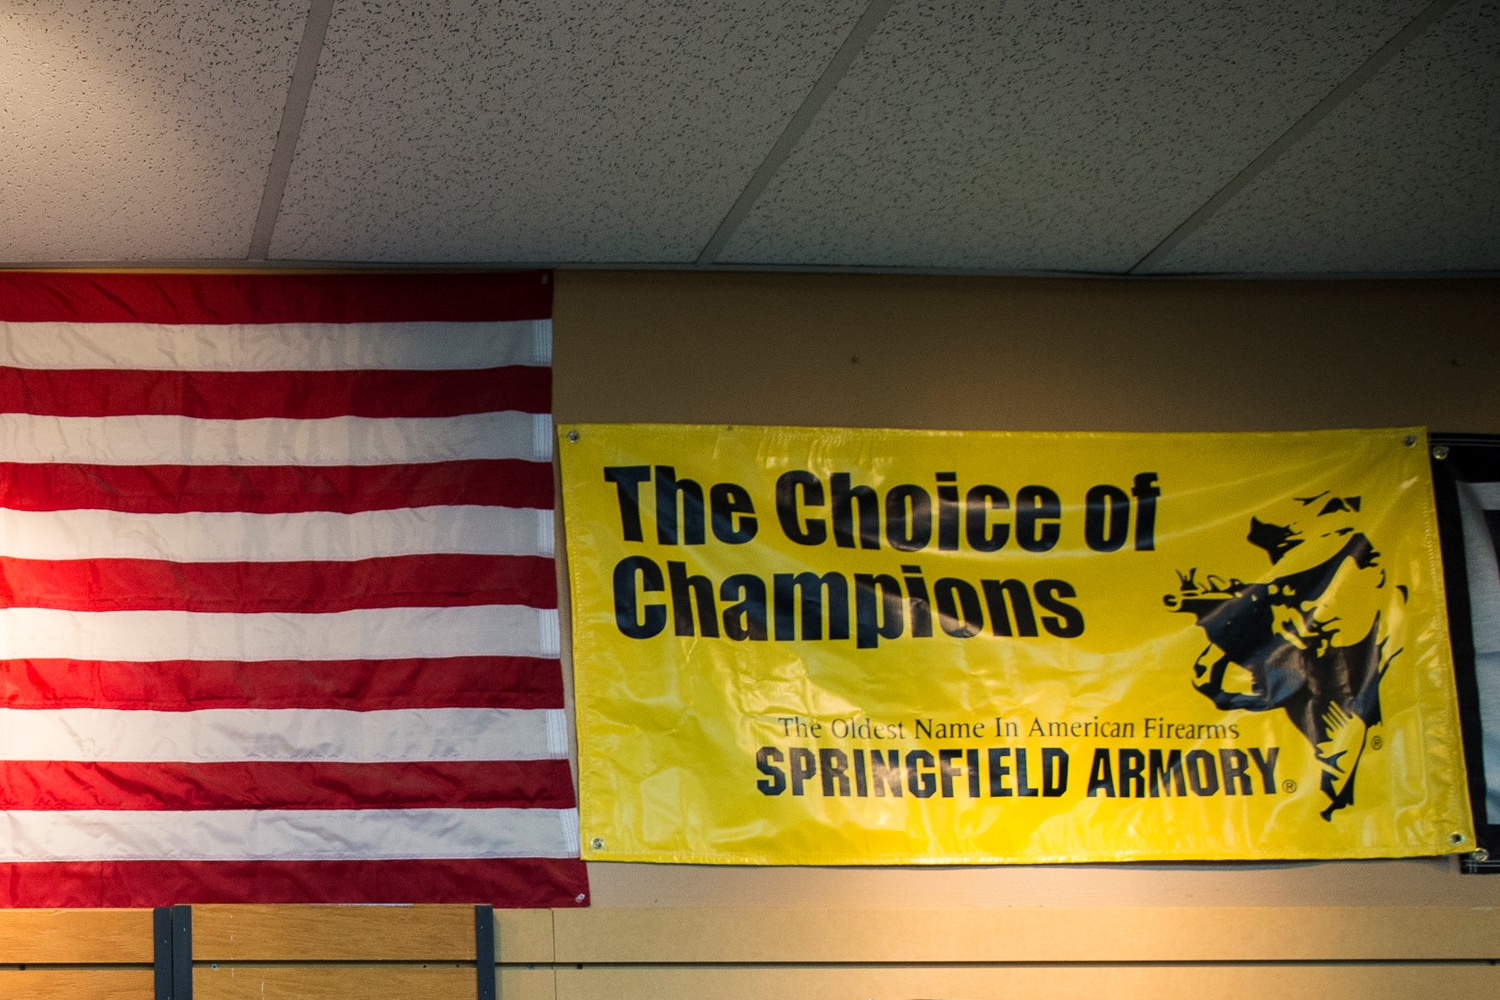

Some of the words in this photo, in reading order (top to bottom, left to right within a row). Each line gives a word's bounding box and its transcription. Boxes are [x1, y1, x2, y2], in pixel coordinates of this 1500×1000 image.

[605, 465, 758, 546] The
[776, 470, 1061, 555] Choice
[1084, 471, 1162, 552] of
[612, 554, 1085, 649] Champions
[778, 715, 823, 740] The
[830, 717, 908, 741] Oldest
[915, 719, 985, 740] Name
[995, 718, 1019, 740] In
[1029, 717, 1135, 742] American
[1145, 717, 1240, 742] Firearms
[755, 746, 1070, 799] SPRINGFIELD
